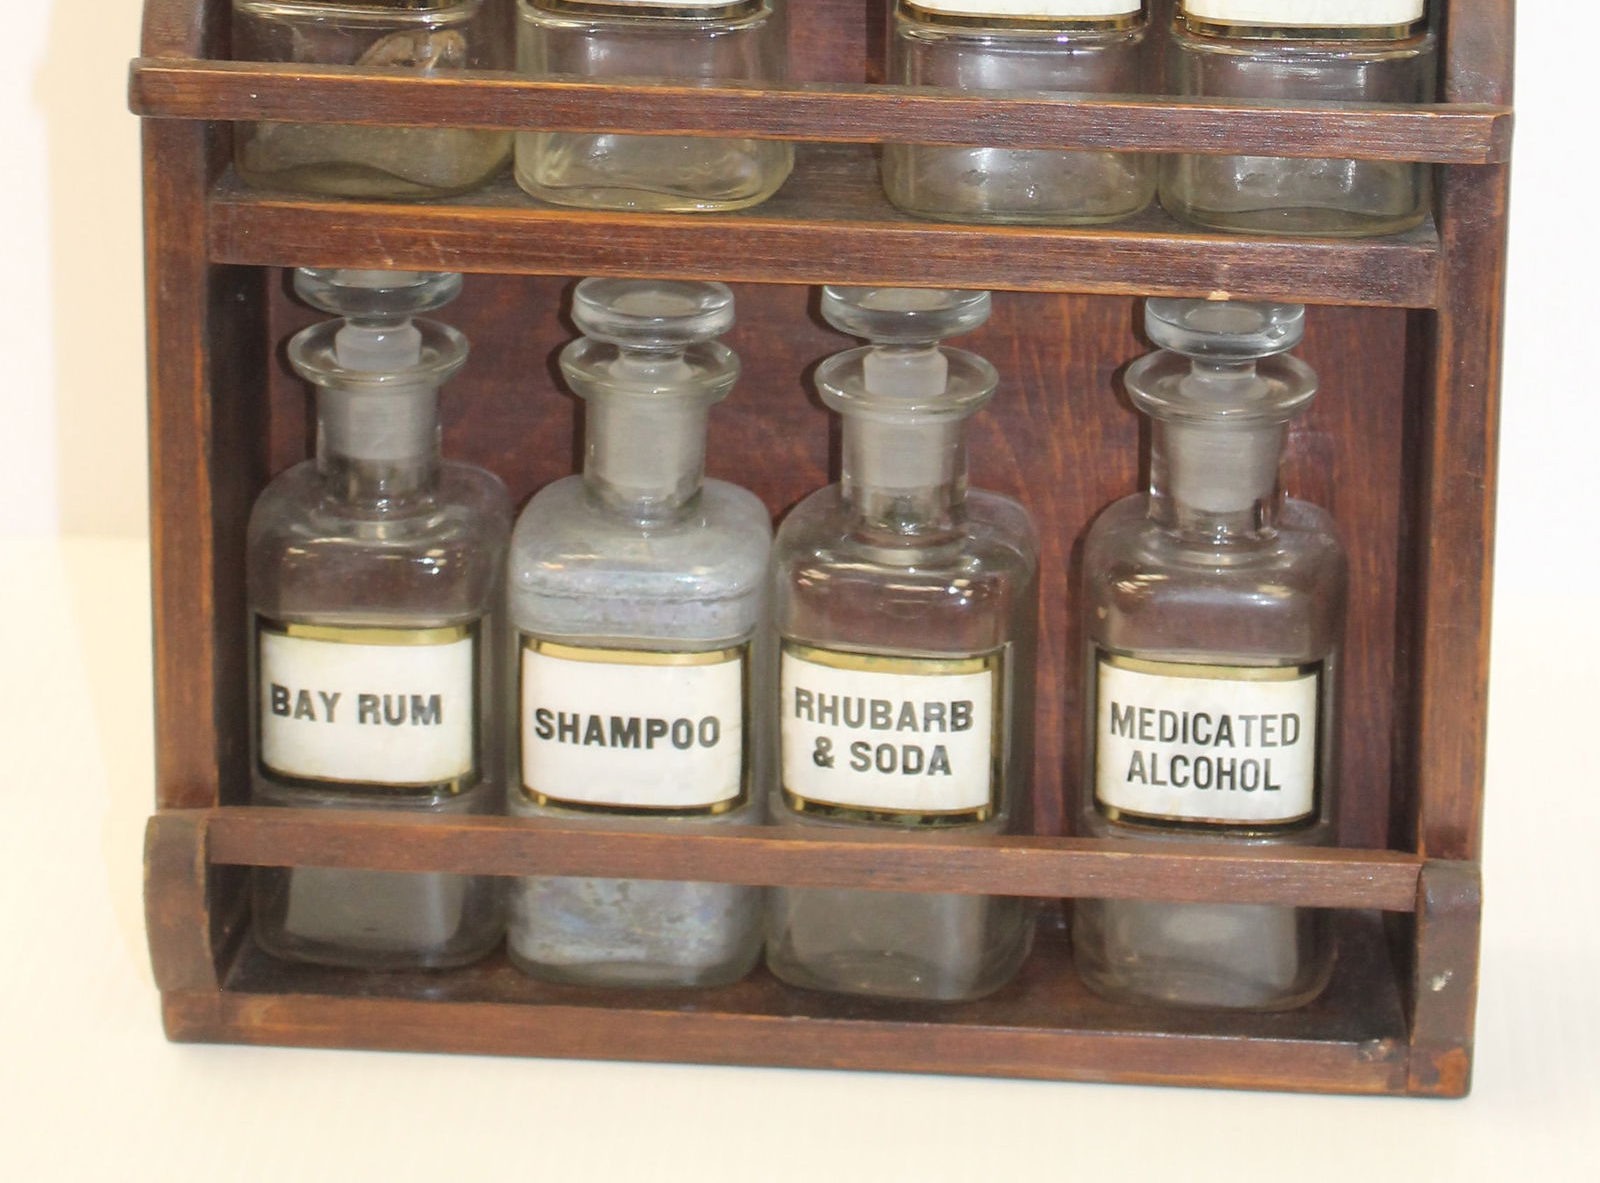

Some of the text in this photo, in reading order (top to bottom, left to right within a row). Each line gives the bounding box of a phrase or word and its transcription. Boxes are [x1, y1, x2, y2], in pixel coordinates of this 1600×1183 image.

[271, 683, 442, 725] BAY RUM
[796, 687, 972, 730] RHUBARB
[1111, 702, 1299, 747] MEDICATED
[535, 708, 719, 749] SHAMPOO
[813, 737, 951, 775] & SODA
[1127, 751, 1280, 791] ALCOHOL
